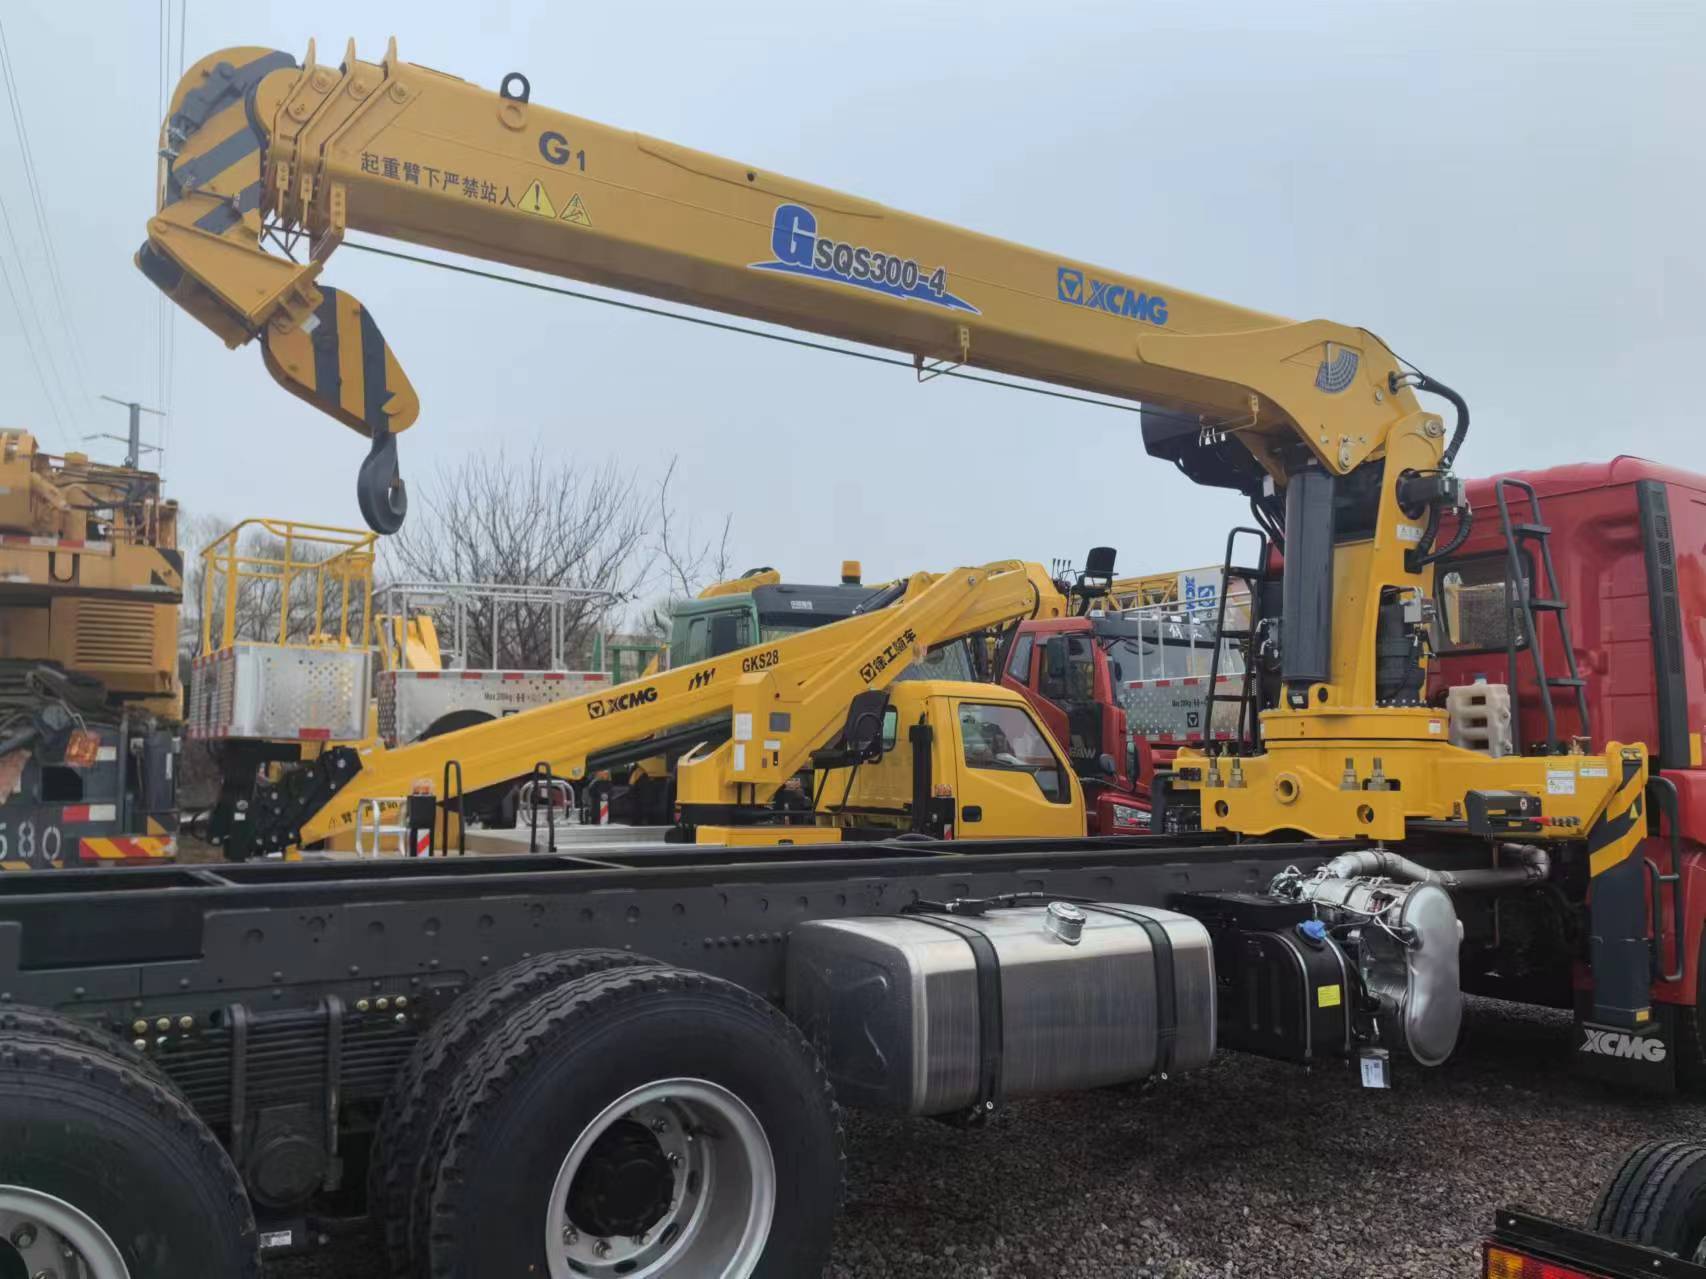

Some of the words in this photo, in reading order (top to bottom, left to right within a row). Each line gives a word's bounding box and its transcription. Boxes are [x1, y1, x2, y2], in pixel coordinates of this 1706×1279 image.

[360, 151, 516, 208] 起重臂下严禁站人
[1086, 279, 1169, 325] XCMG
[742, 650, 779, 673] GKS28
[607, 687, 658, 714] XCMG
[1579, 1029, 1666, 1062] XCMG
